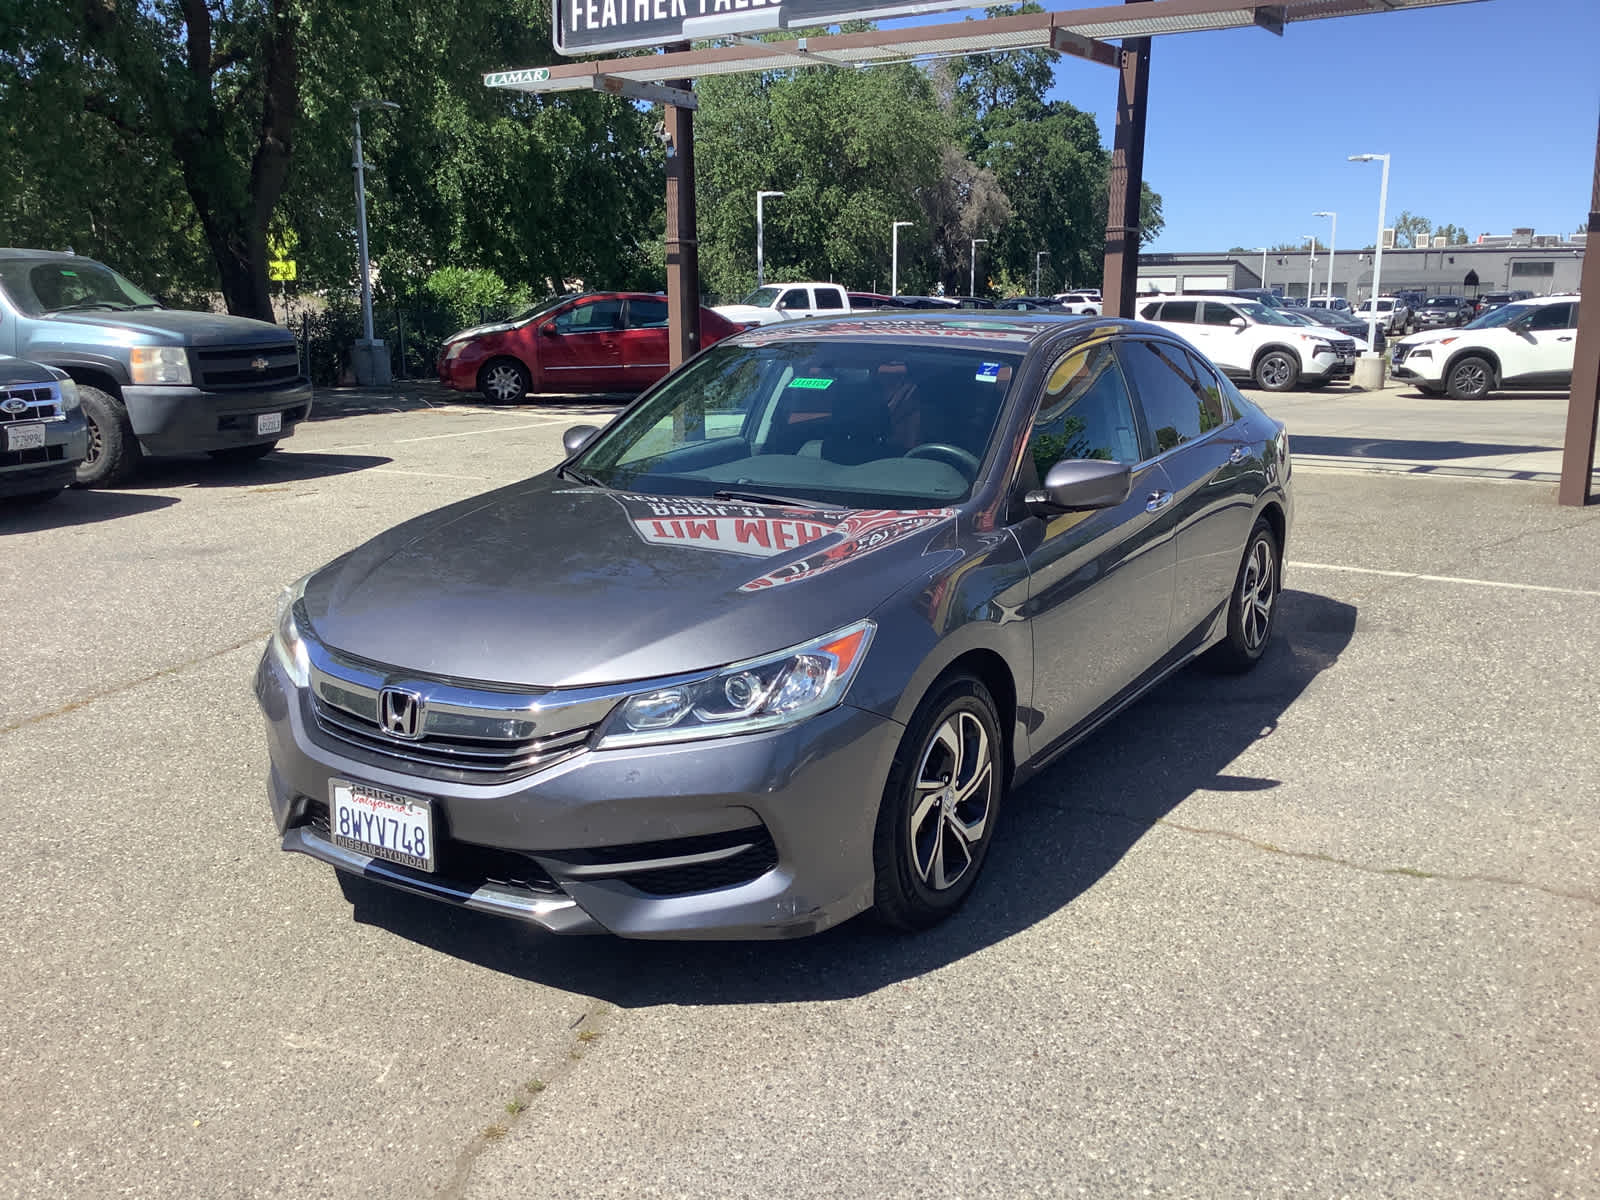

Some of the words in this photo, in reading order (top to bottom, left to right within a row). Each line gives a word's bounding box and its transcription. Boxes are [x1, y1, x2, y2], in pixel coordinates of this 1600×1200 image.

[490, 71, 543, 85] LAMAR
[340, 806, 425, 857] 8WYV748
[336, 835, 428, 869] NISSAN-HYUNDAI
